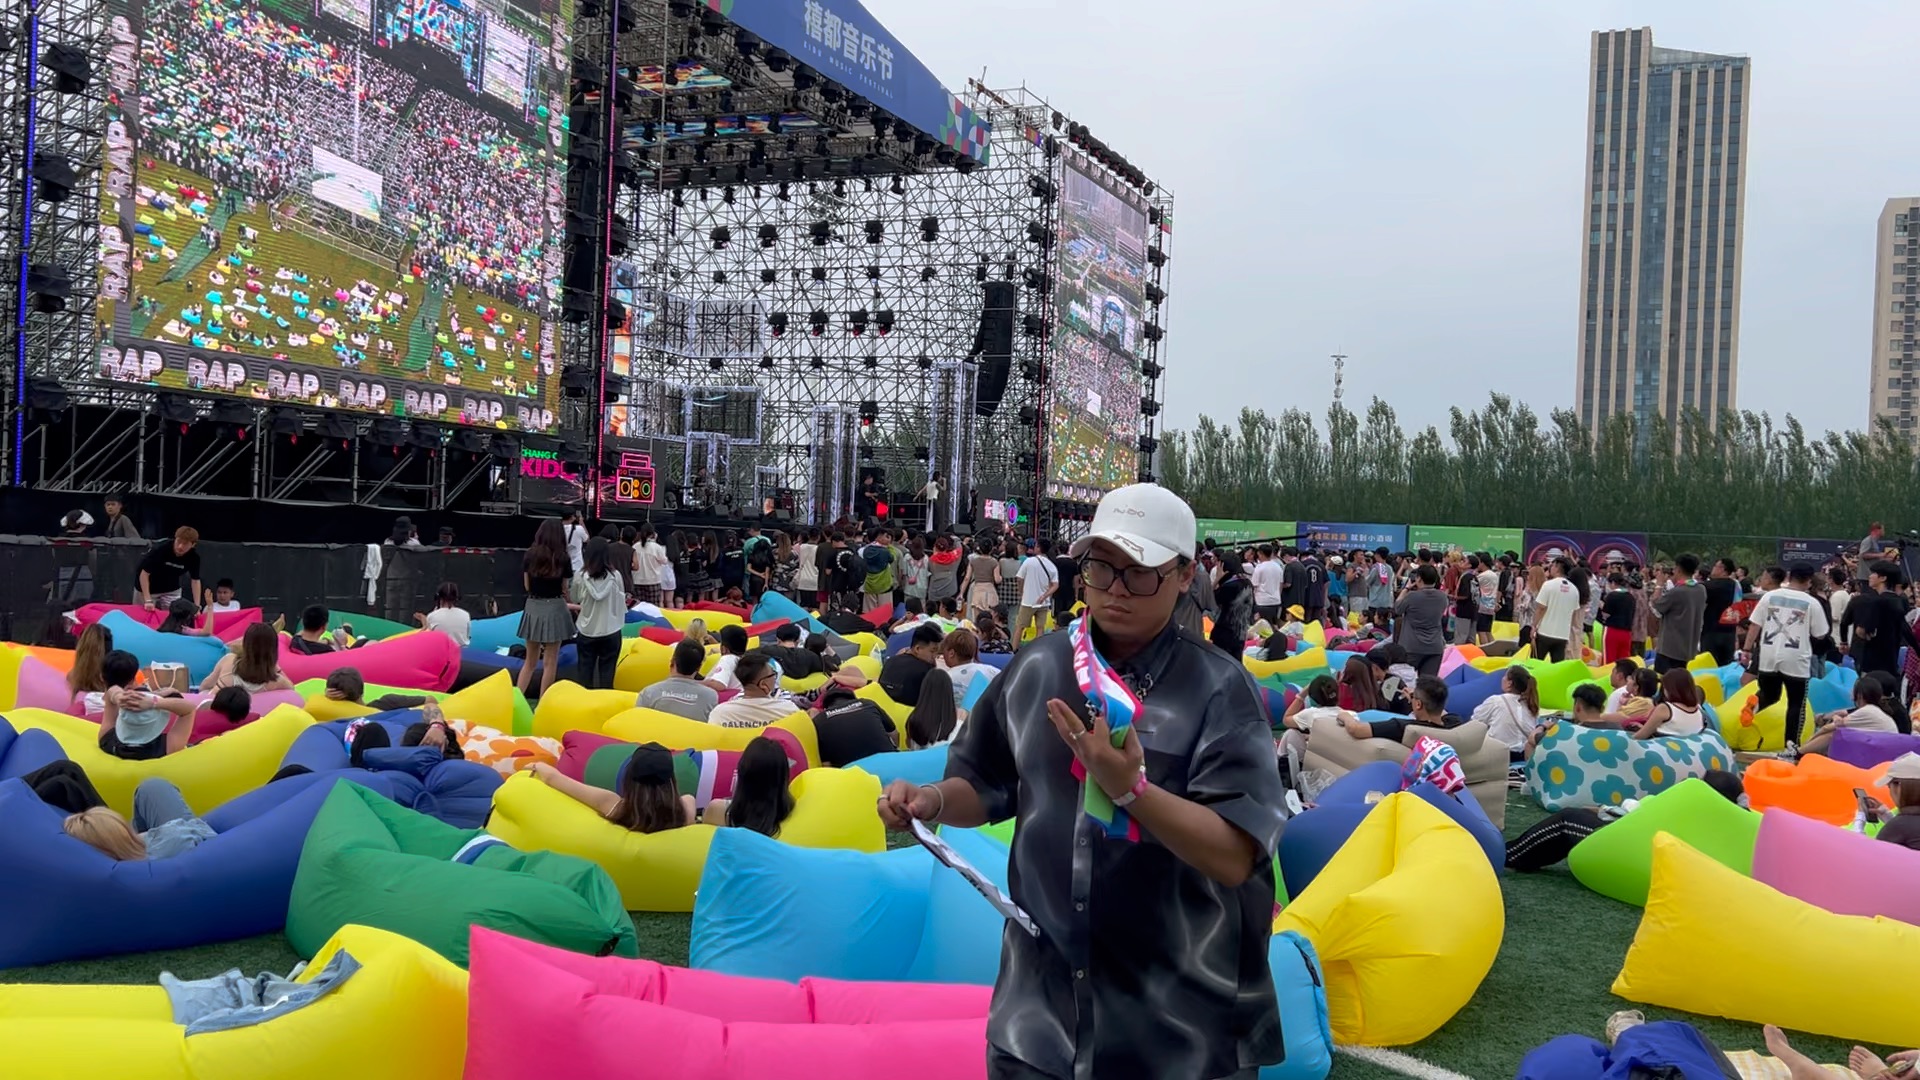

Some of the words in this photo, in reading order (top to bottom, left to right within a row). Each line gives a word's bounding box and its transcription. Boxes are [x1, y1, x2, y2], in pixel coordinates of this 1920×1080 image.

[804, 0, 894, 80] 禧都音乐节
[100, 346, 164, 382] RAP
[187, 357, 247, 392] RAP
[267, 368, 320, 400] RAP
[338, 379, 387, 409] RAP
[403, 388, 448, 418] RAP
[463, 397, 504, 424] RAP
[518, 404, 553, 431] RAP
[661, 690, 698, 699] Balenciaga
[826, 701, 863, 716] Balenciaga
